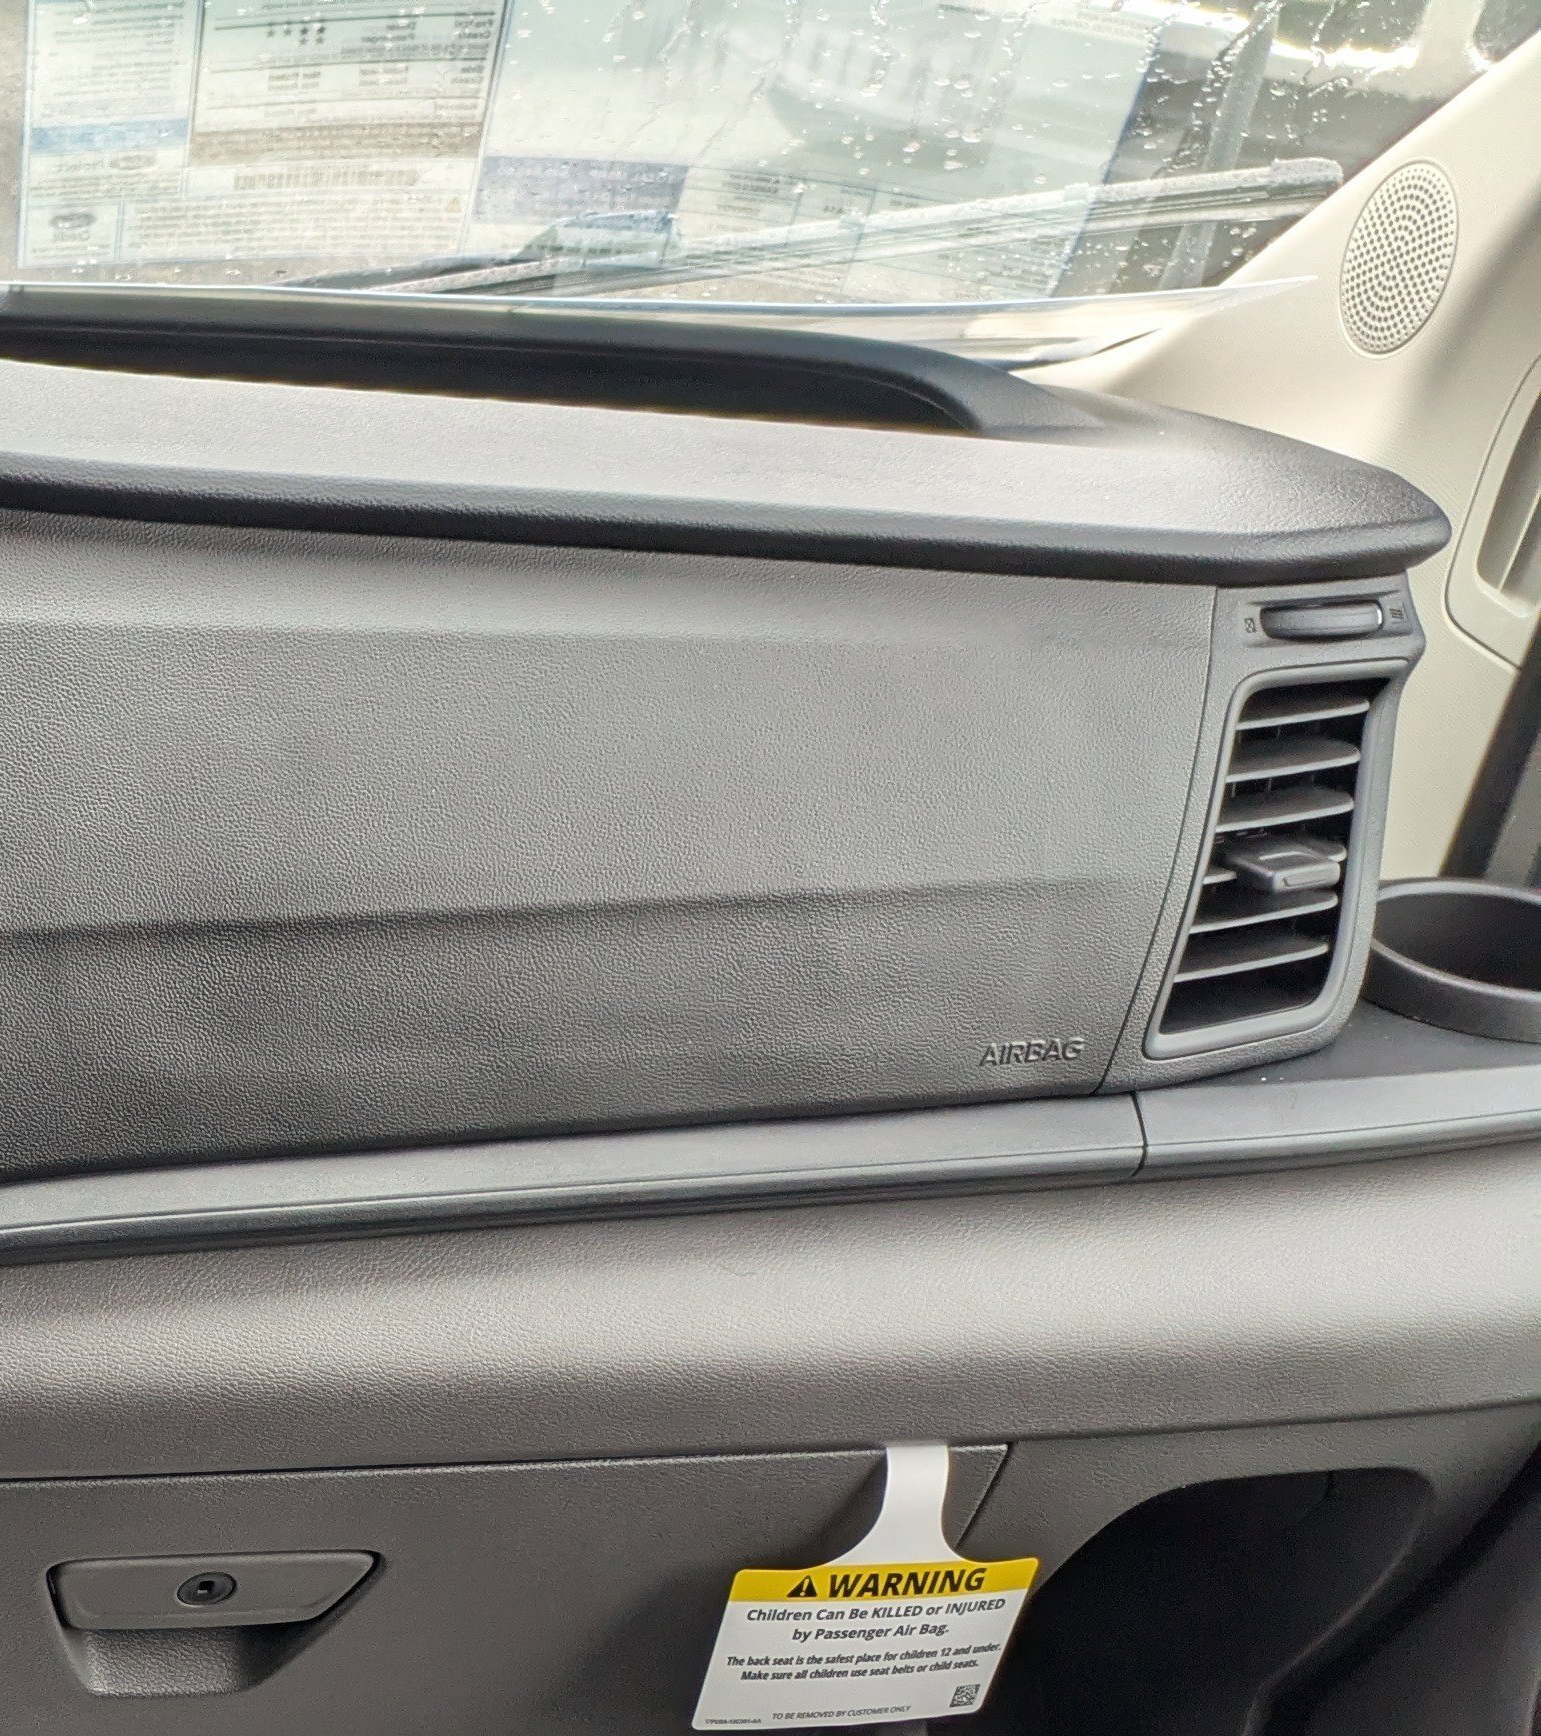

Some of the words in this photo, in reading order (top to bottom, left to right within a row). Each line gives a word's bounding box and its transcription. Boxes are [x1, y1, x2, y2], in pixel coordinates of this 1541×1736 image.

[979, 1036, 1085, 1067] AIRBAG
[828, 1567, 987, 1599] WARNING
[746, 1608, 812, 1622] Children
[817, 1609, 845, 1621] Can
[850, 1608, 868, 1620] Be
[872, 1605, 923, 1619] KILLED
[925, 1606, 943, 1616] or
[945, 1598, 1006, 1615] INJURED
[792, 1628, 811, 1643] by
[815, 1626, 892, 1643] Passenger
[893, 1624, 916, 1637] Air
[919, 1622, 950, 1638] Bag.
[726, 1656, 745, 1666] The
[747, 1655, 770, 1666] back
[772, 1656, 794, 1666] seat
[795, 1656, 805, 1665] is
[806, 1654, 823, 1665] the
[825, 1654, 854, 1664] safest
[855, 1653, 881, 1665] place
[883, 1651, 897, 1662] for
[899, 1649, 938, 1661] children
[940, 1647, 951, 1657] 12
[952, 1646, 971, 1656] and
[740, 1670, 769, 1680] Make
[770, 1671, 792, 1680] sure
[793, 1669, 808, 1680] all
[809, 1667, 848, 1679] children
[850, 1669, 867, 1678] use
[869, 1666, 890, 1677] seat
[891, 1664, 914, 1675] belts
[916, 1664, 927, 1673] or
[929, 1661, 952, 1672] child
[796, 1711, 834, 1719] REMOVED
[847, 1707, 889, 1717] CUSTOMER
[890, 1705, 911, 1713] ONLY
